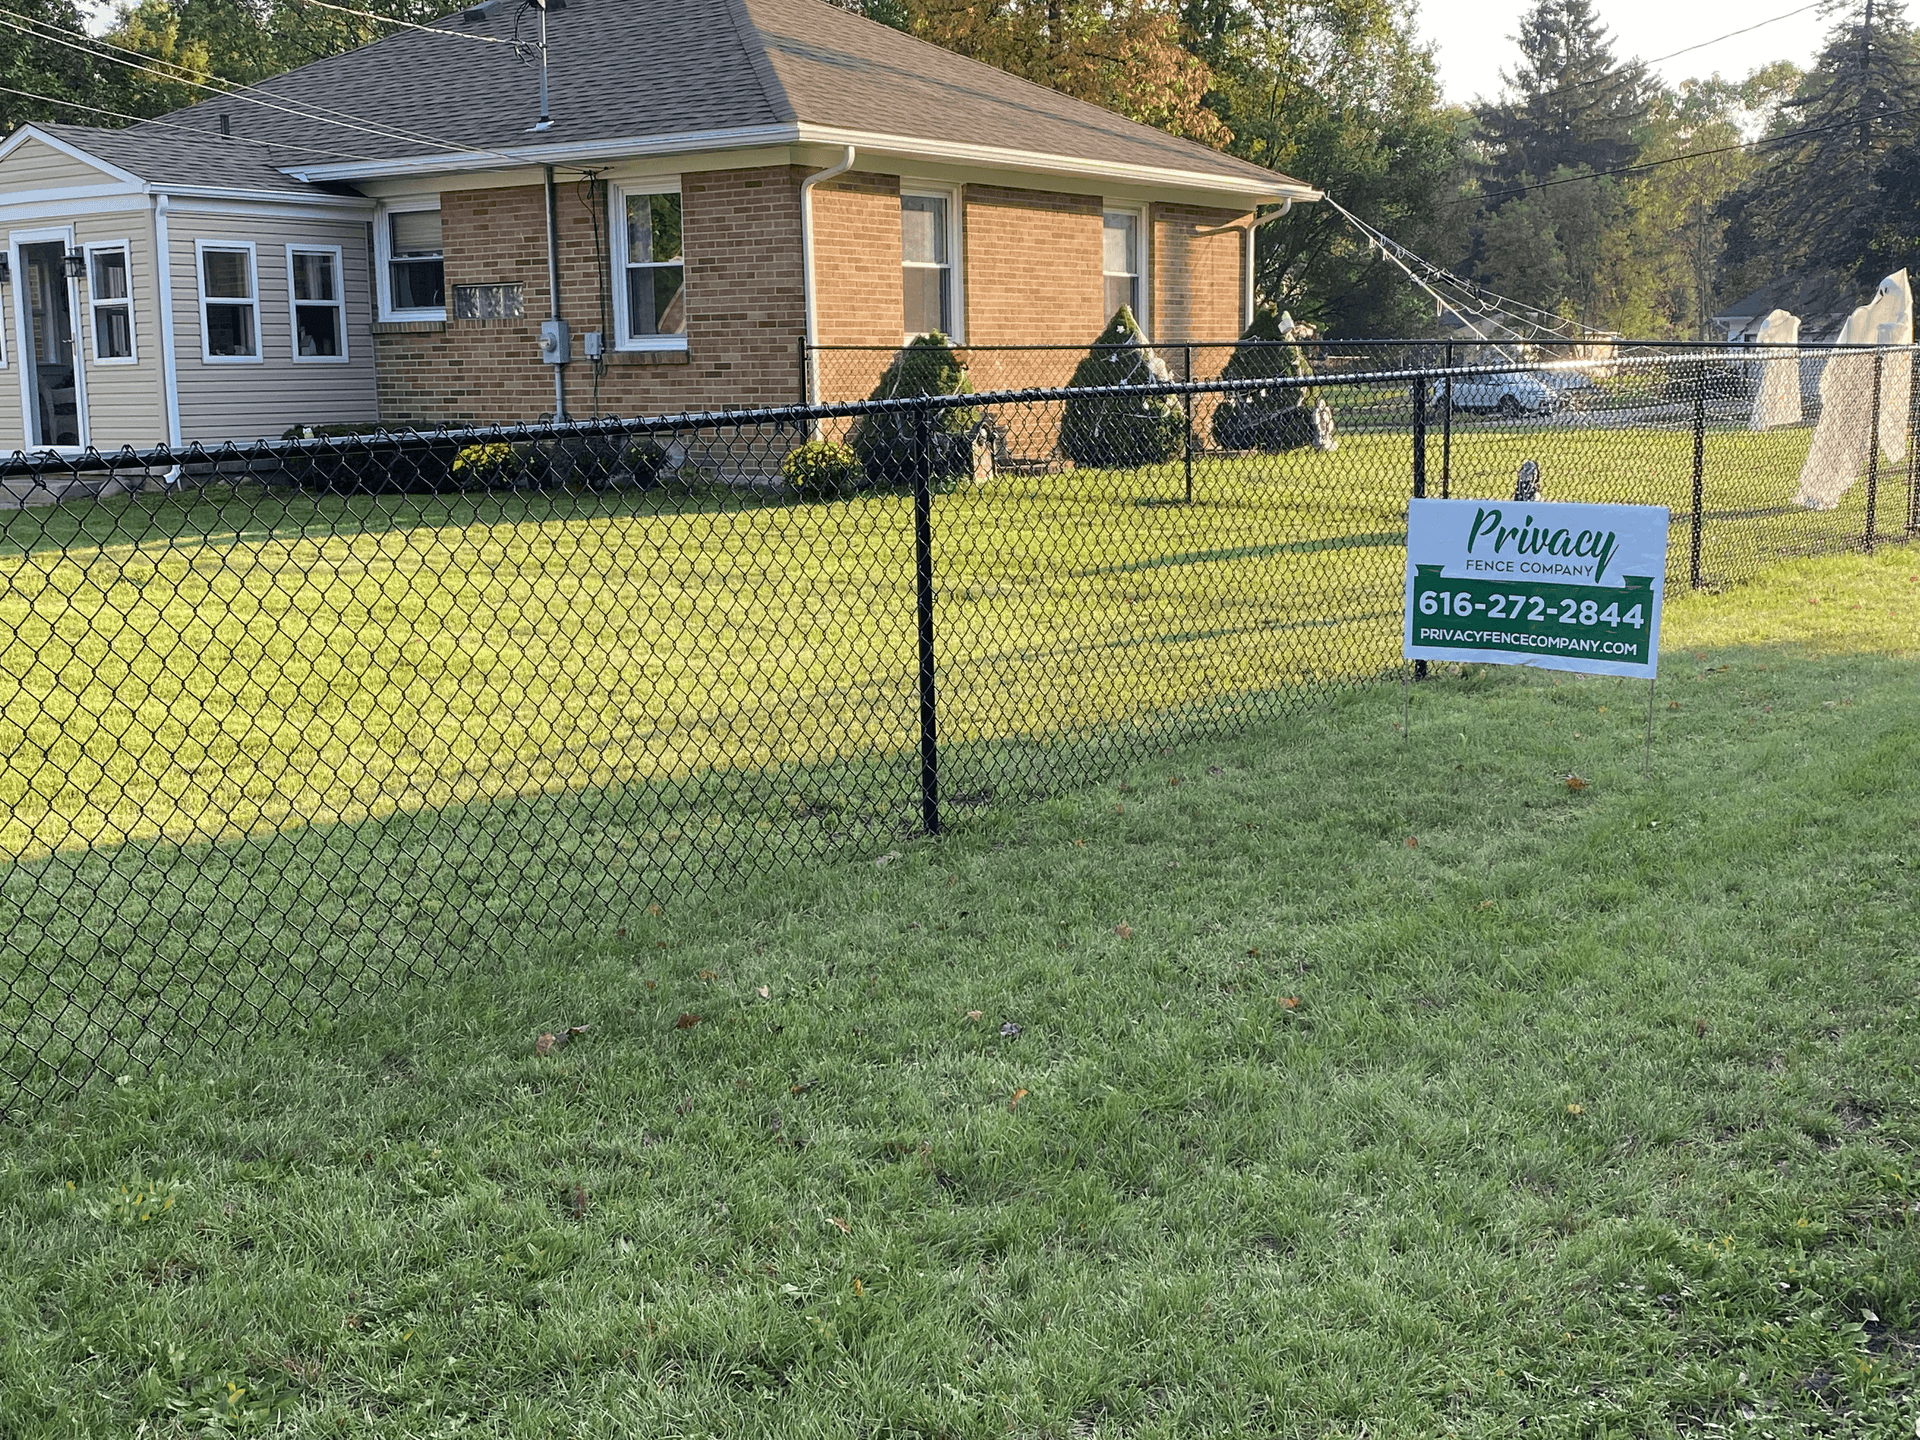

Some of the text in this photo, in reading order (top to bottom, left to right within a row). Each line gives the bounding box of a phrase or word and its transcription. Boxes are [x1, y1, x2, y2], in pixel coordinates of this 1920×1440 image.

[1467, 507, 1619, 584] Privacy
[1466, 559, 1594, 577] FENCE COMPANY
[1419, 590, 1644, 629] 616-272-2844
[1420, 628, 1637, 656] PRIVACYFENCECOMPANY.COM
